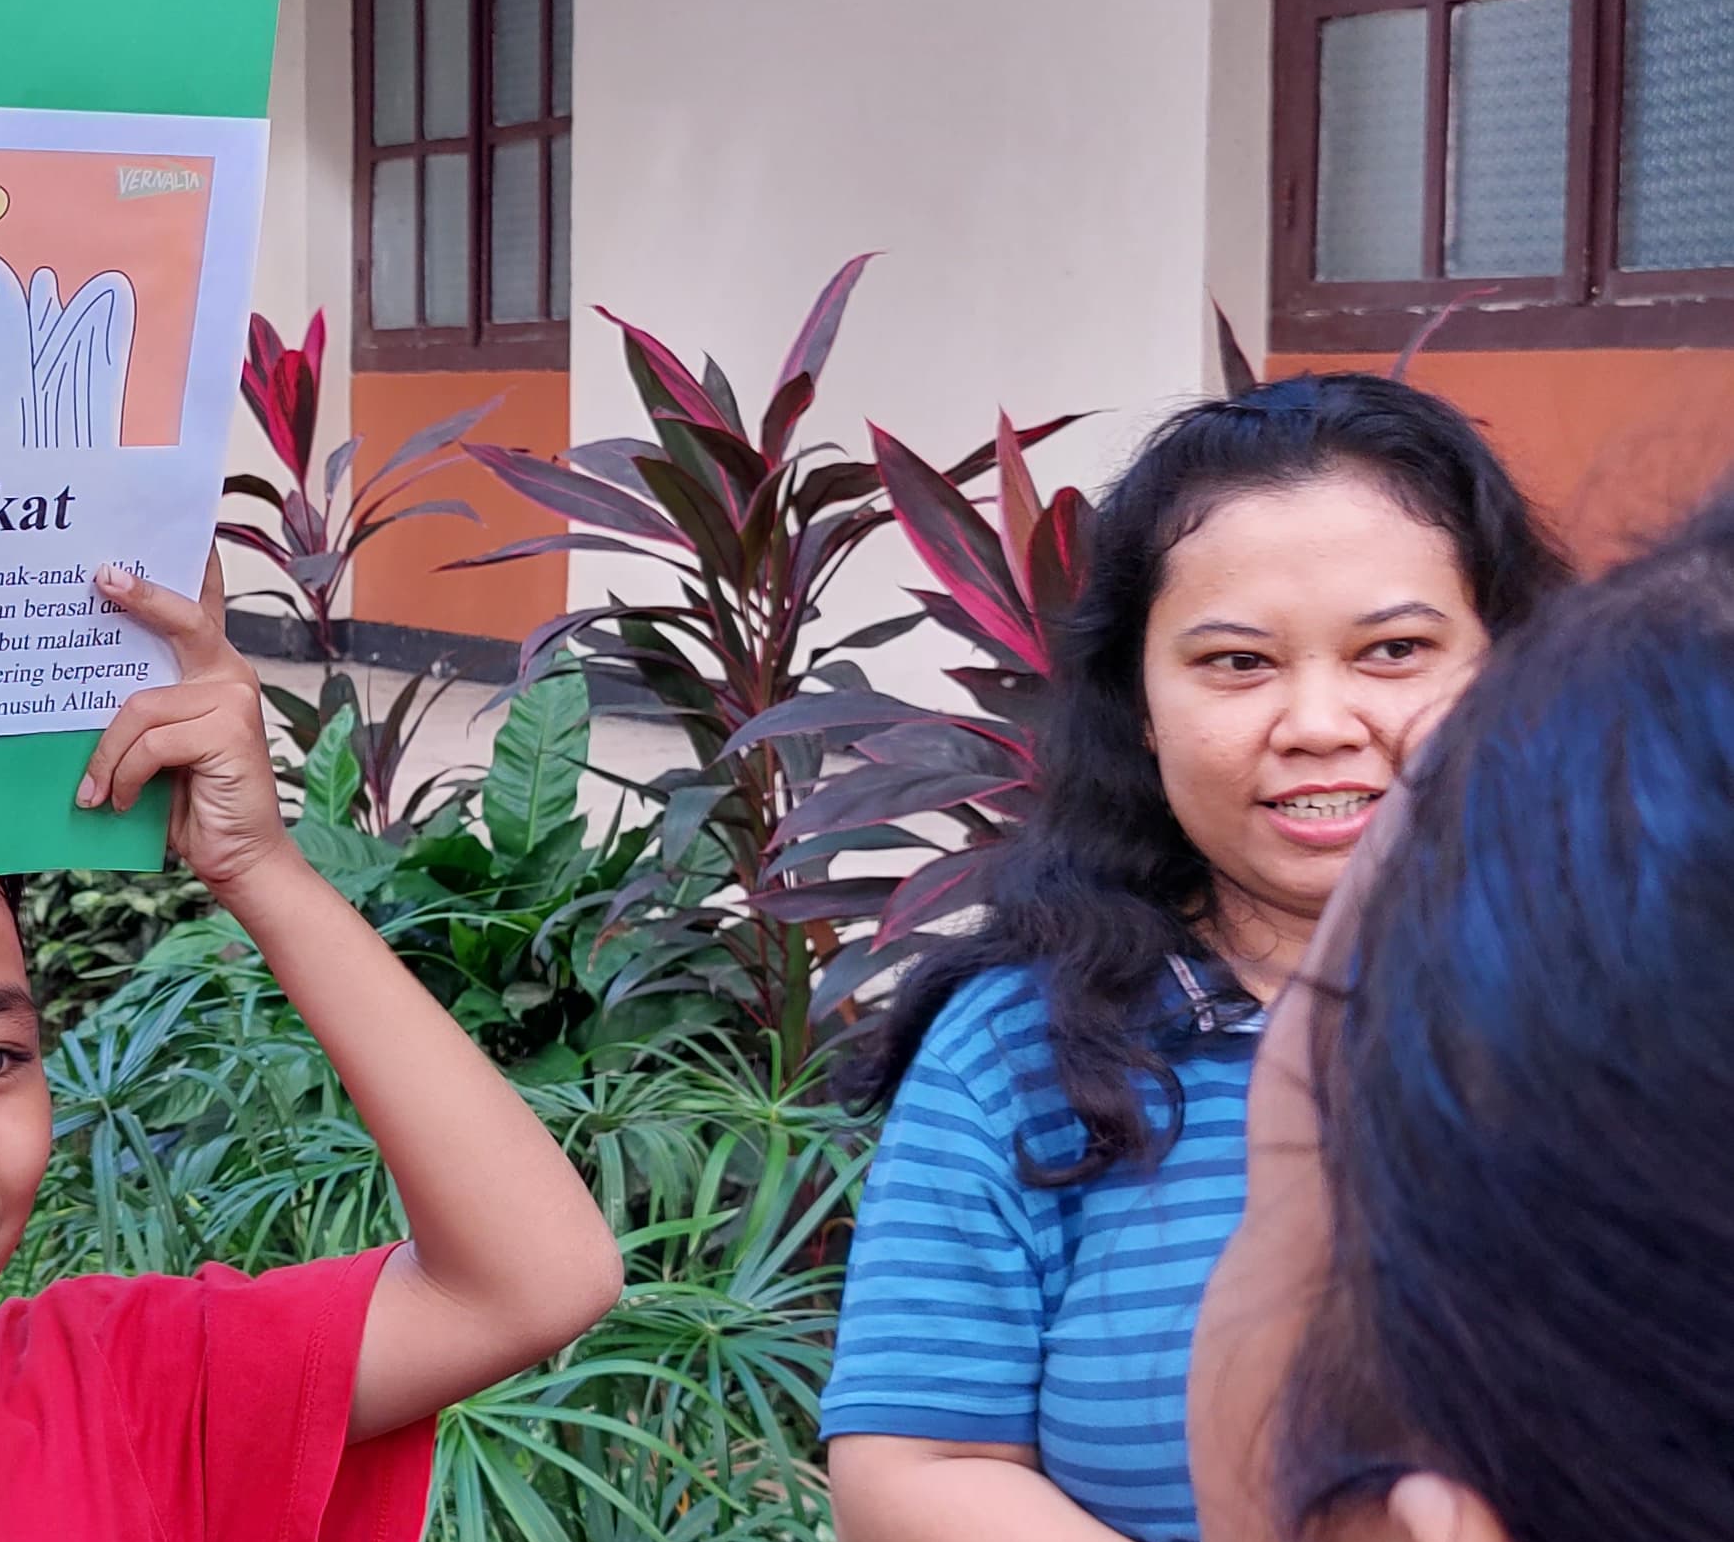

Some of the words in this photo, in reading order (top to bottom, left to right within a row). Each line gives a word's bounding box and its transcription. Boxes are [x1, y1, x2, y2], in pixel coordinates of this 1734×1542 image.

[119, 168, 199, 195] VERNALTA
[24, 595, 95, 618] berasal
[36, 627, 123, 651] malaikat
[52, 661, 149, 684] berperang
[61, 690, 122, 712] Allah.
